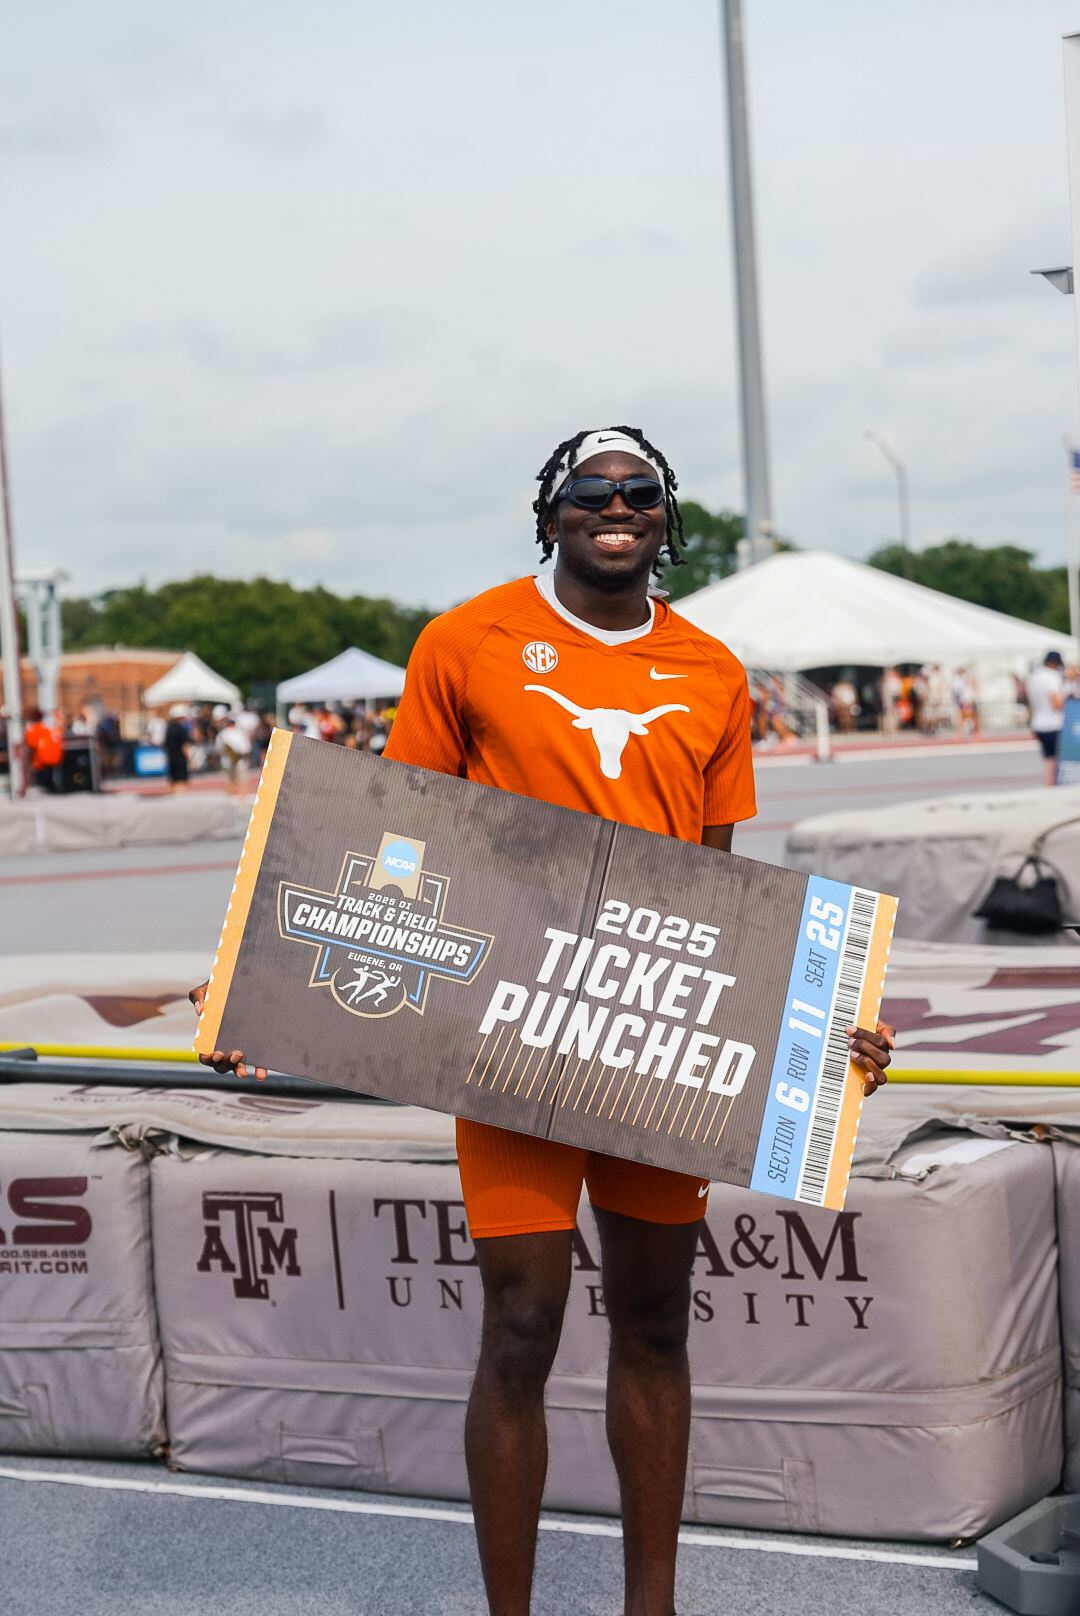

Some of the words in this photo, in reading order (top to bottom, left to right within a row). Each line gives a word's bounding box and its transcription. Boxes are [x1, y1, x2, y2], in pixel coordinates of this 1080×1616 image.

[524, 642, 556, 673] SEC
[384, 856, 416, 871] NCAA
[336, 894, 384, 919] TRACK
[383, 907, 396, 922] &
[397, 910, 438, 933] FIELD
[368, 892, 397, 906] 2025
[292, 903, 472, 967] CHAMPIONSHIPS
[595, 899, 721, 958] 2025
[805, 895, 845, 952] 25
[347, 951, 386, 969] EUGENE,
[388, 962, 403, 972] OR
[536, 927, 737, 1026] TICKET
[804, 947, 829, 988] SEAT
[478, 980, 757, 1097] PUNCHED
[788, 997, 827, 1039] 11
[786, 1043, 811, 1082] ROW
[775, 1080, 810, 1113] 6
[767, 1115, 798, 1183] SECTION
[690, 1208, 869, 1283] A&M
[385, 1276, 875, 1330] UNESITY
